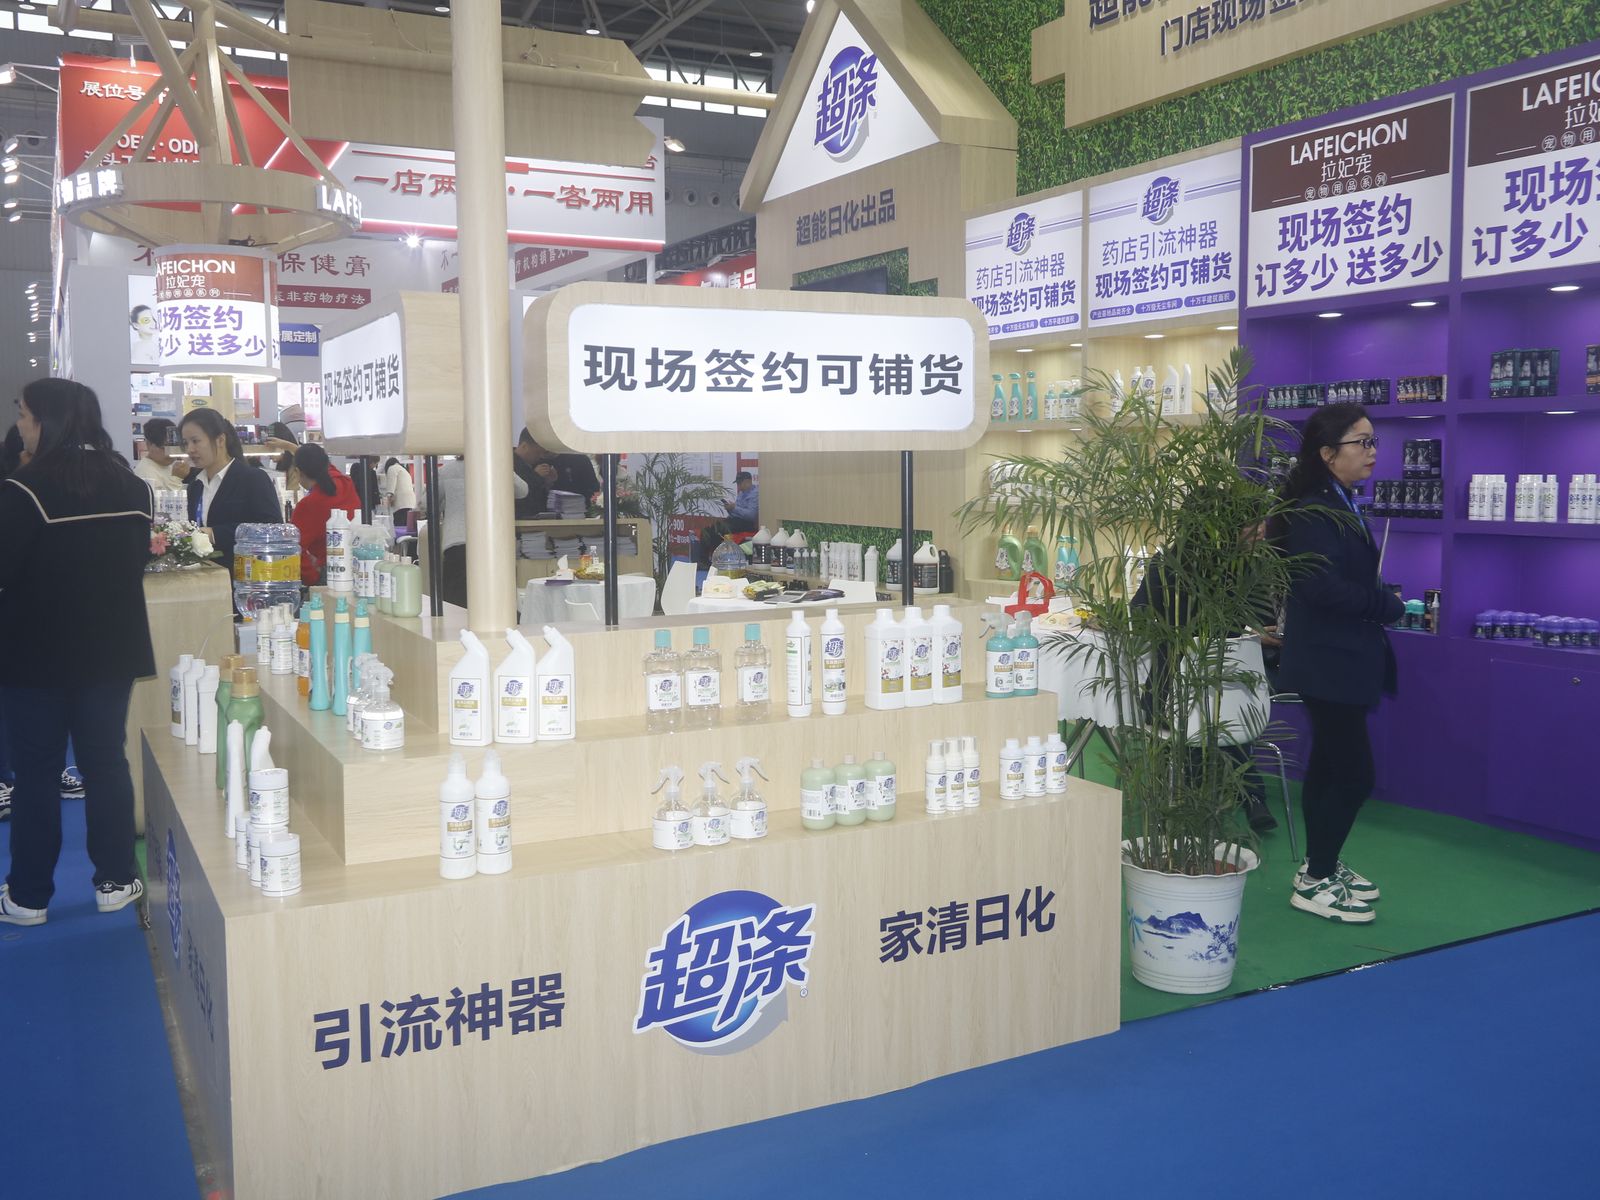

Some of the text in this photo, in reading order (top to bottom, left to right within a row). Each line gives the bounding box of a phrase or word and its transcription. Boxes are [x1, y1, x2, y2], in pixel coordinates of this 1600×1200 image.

[79, 80, 147, 101] 展位号
[1290, 118, 1408, 166] LAFEICHON
[1304, 172, 1388, 201] 宠物用品系列
[1321, 153, 1372, 182] 拉妃宠
[1503, 156, 1600, 214] 现场
[796, 188, 896, 247] 超能日化出品
[1277, 193, 1413, 254] 现场签约
[1471, 211, 1589, 267] 订多少
[156, 258, 236, 277] AFEICHON
[277, 253, 371, 277] 保健膏
[1101, 220, 1218, 267] 药店引流神器
[1254, 235, 1444, 298] 订多少 送多少
[165, 274, 206, 289] 拉妃宠
[976, 252, 1066, 290] 药店引流神器
[1095, 251, 1233, 299] 现场签约可铺货
[971, 279, 1077, 318] 现场签约可铺货
[188, 332, 266, 357] 送多少
[279, 330, 318, 344] 属定制
[324, 353, 400, 407] 现场签约可铺货
[583, 344, 965, 395] 现场签约可铺货
[879, 885, 1057, 964] 家清日化
[633, 904, 815, 1032] 超涤
[313, 972, 566, 1071] 引流神器
